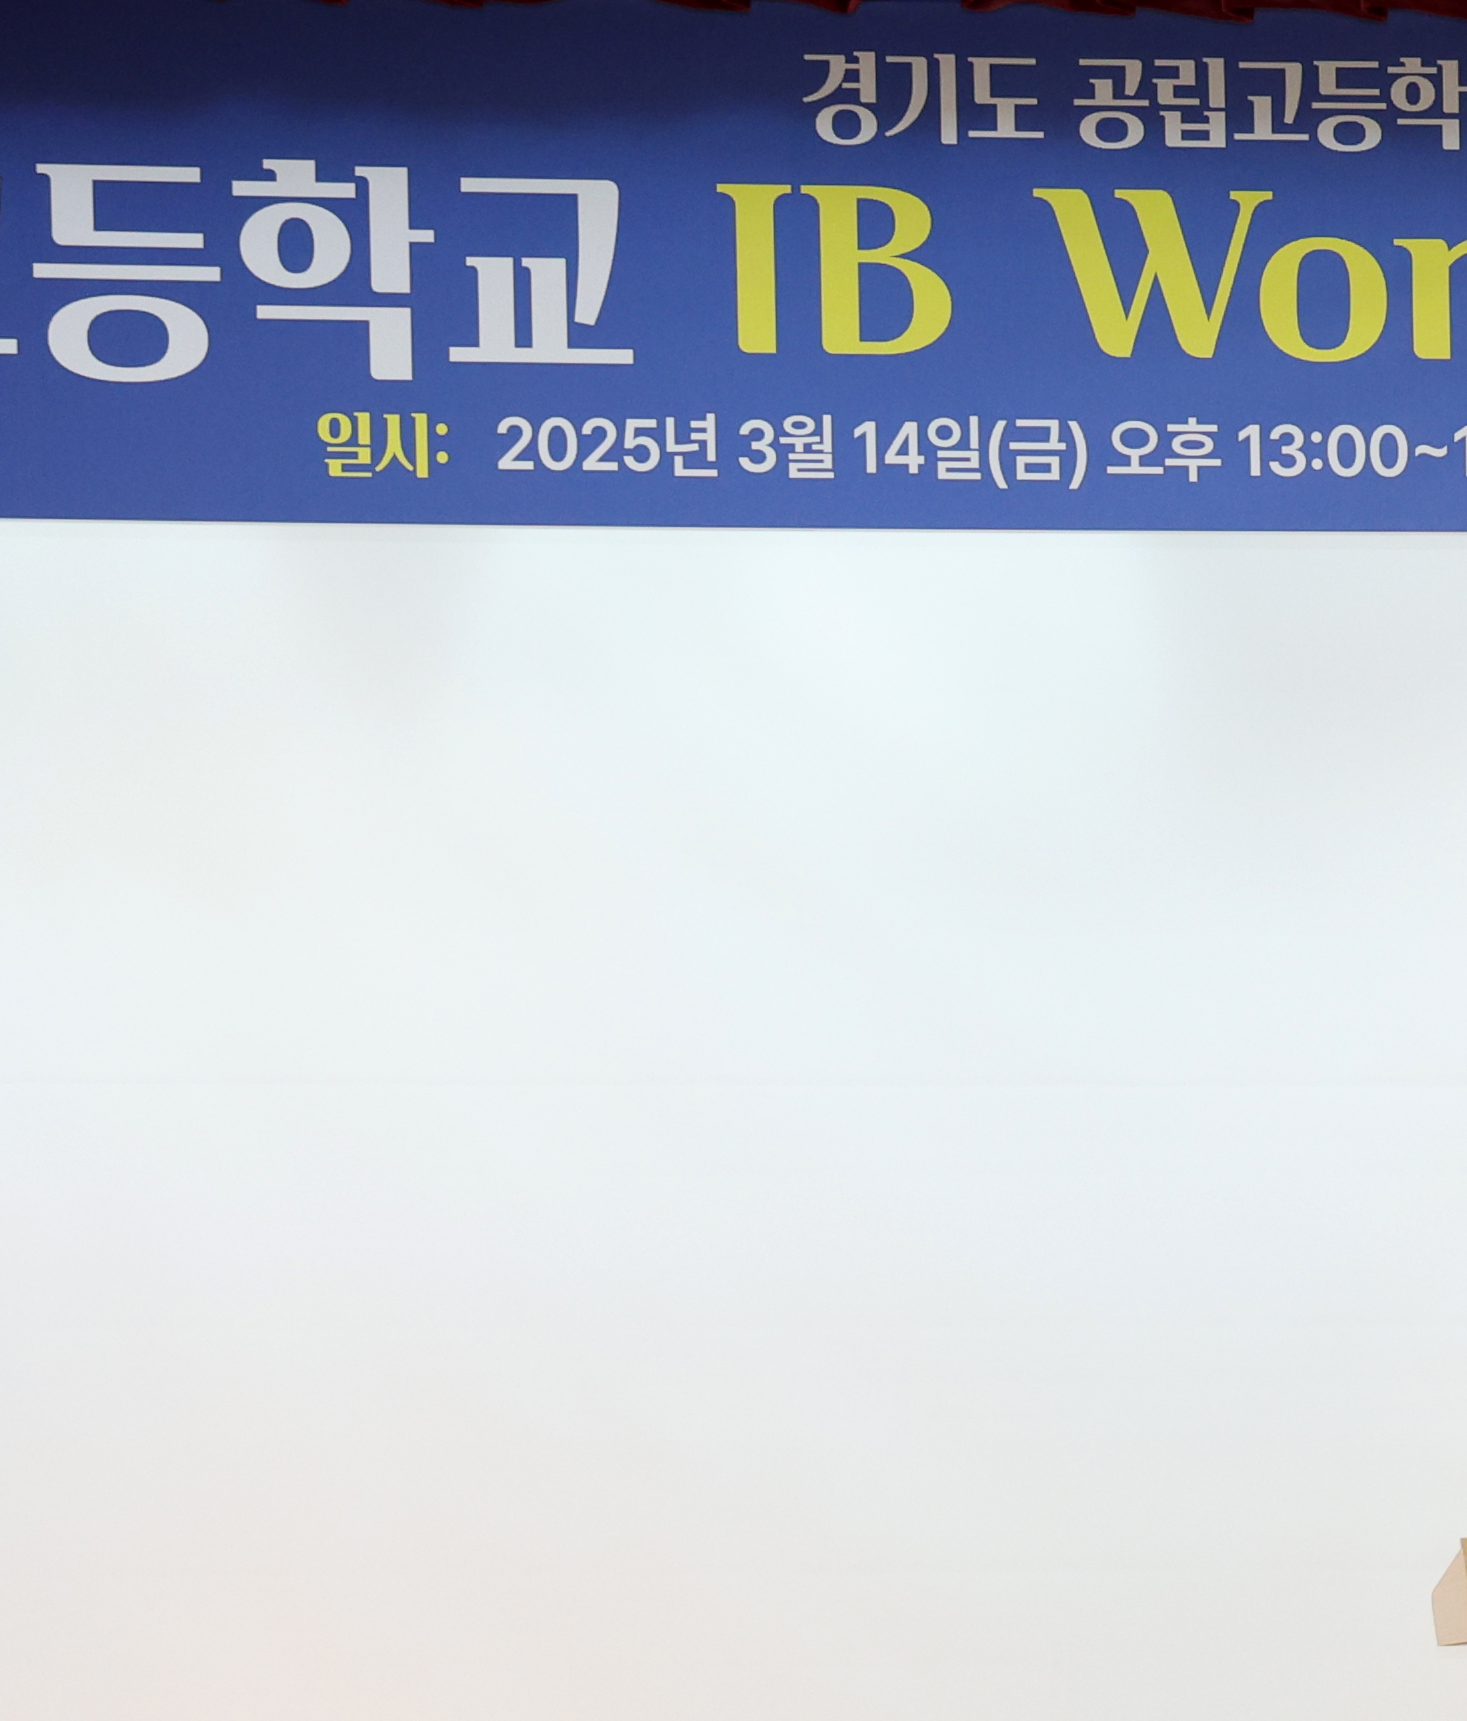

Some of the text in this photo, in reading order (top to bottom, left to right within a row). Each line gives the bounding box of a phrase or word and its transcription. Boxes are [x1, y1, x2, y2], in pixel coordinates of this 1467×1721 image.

[803, 52, 1044, 145] 경기도
[717, 184, 952, 355] IB
[317, 412, 448, 478] 일시:
[497, 413, 718, 477] 2025년
[739, 414, 834, 479] 3월
[854, 416, 1087, 489] 14일(금)
[1106, 417, 1222, 482] 오후
